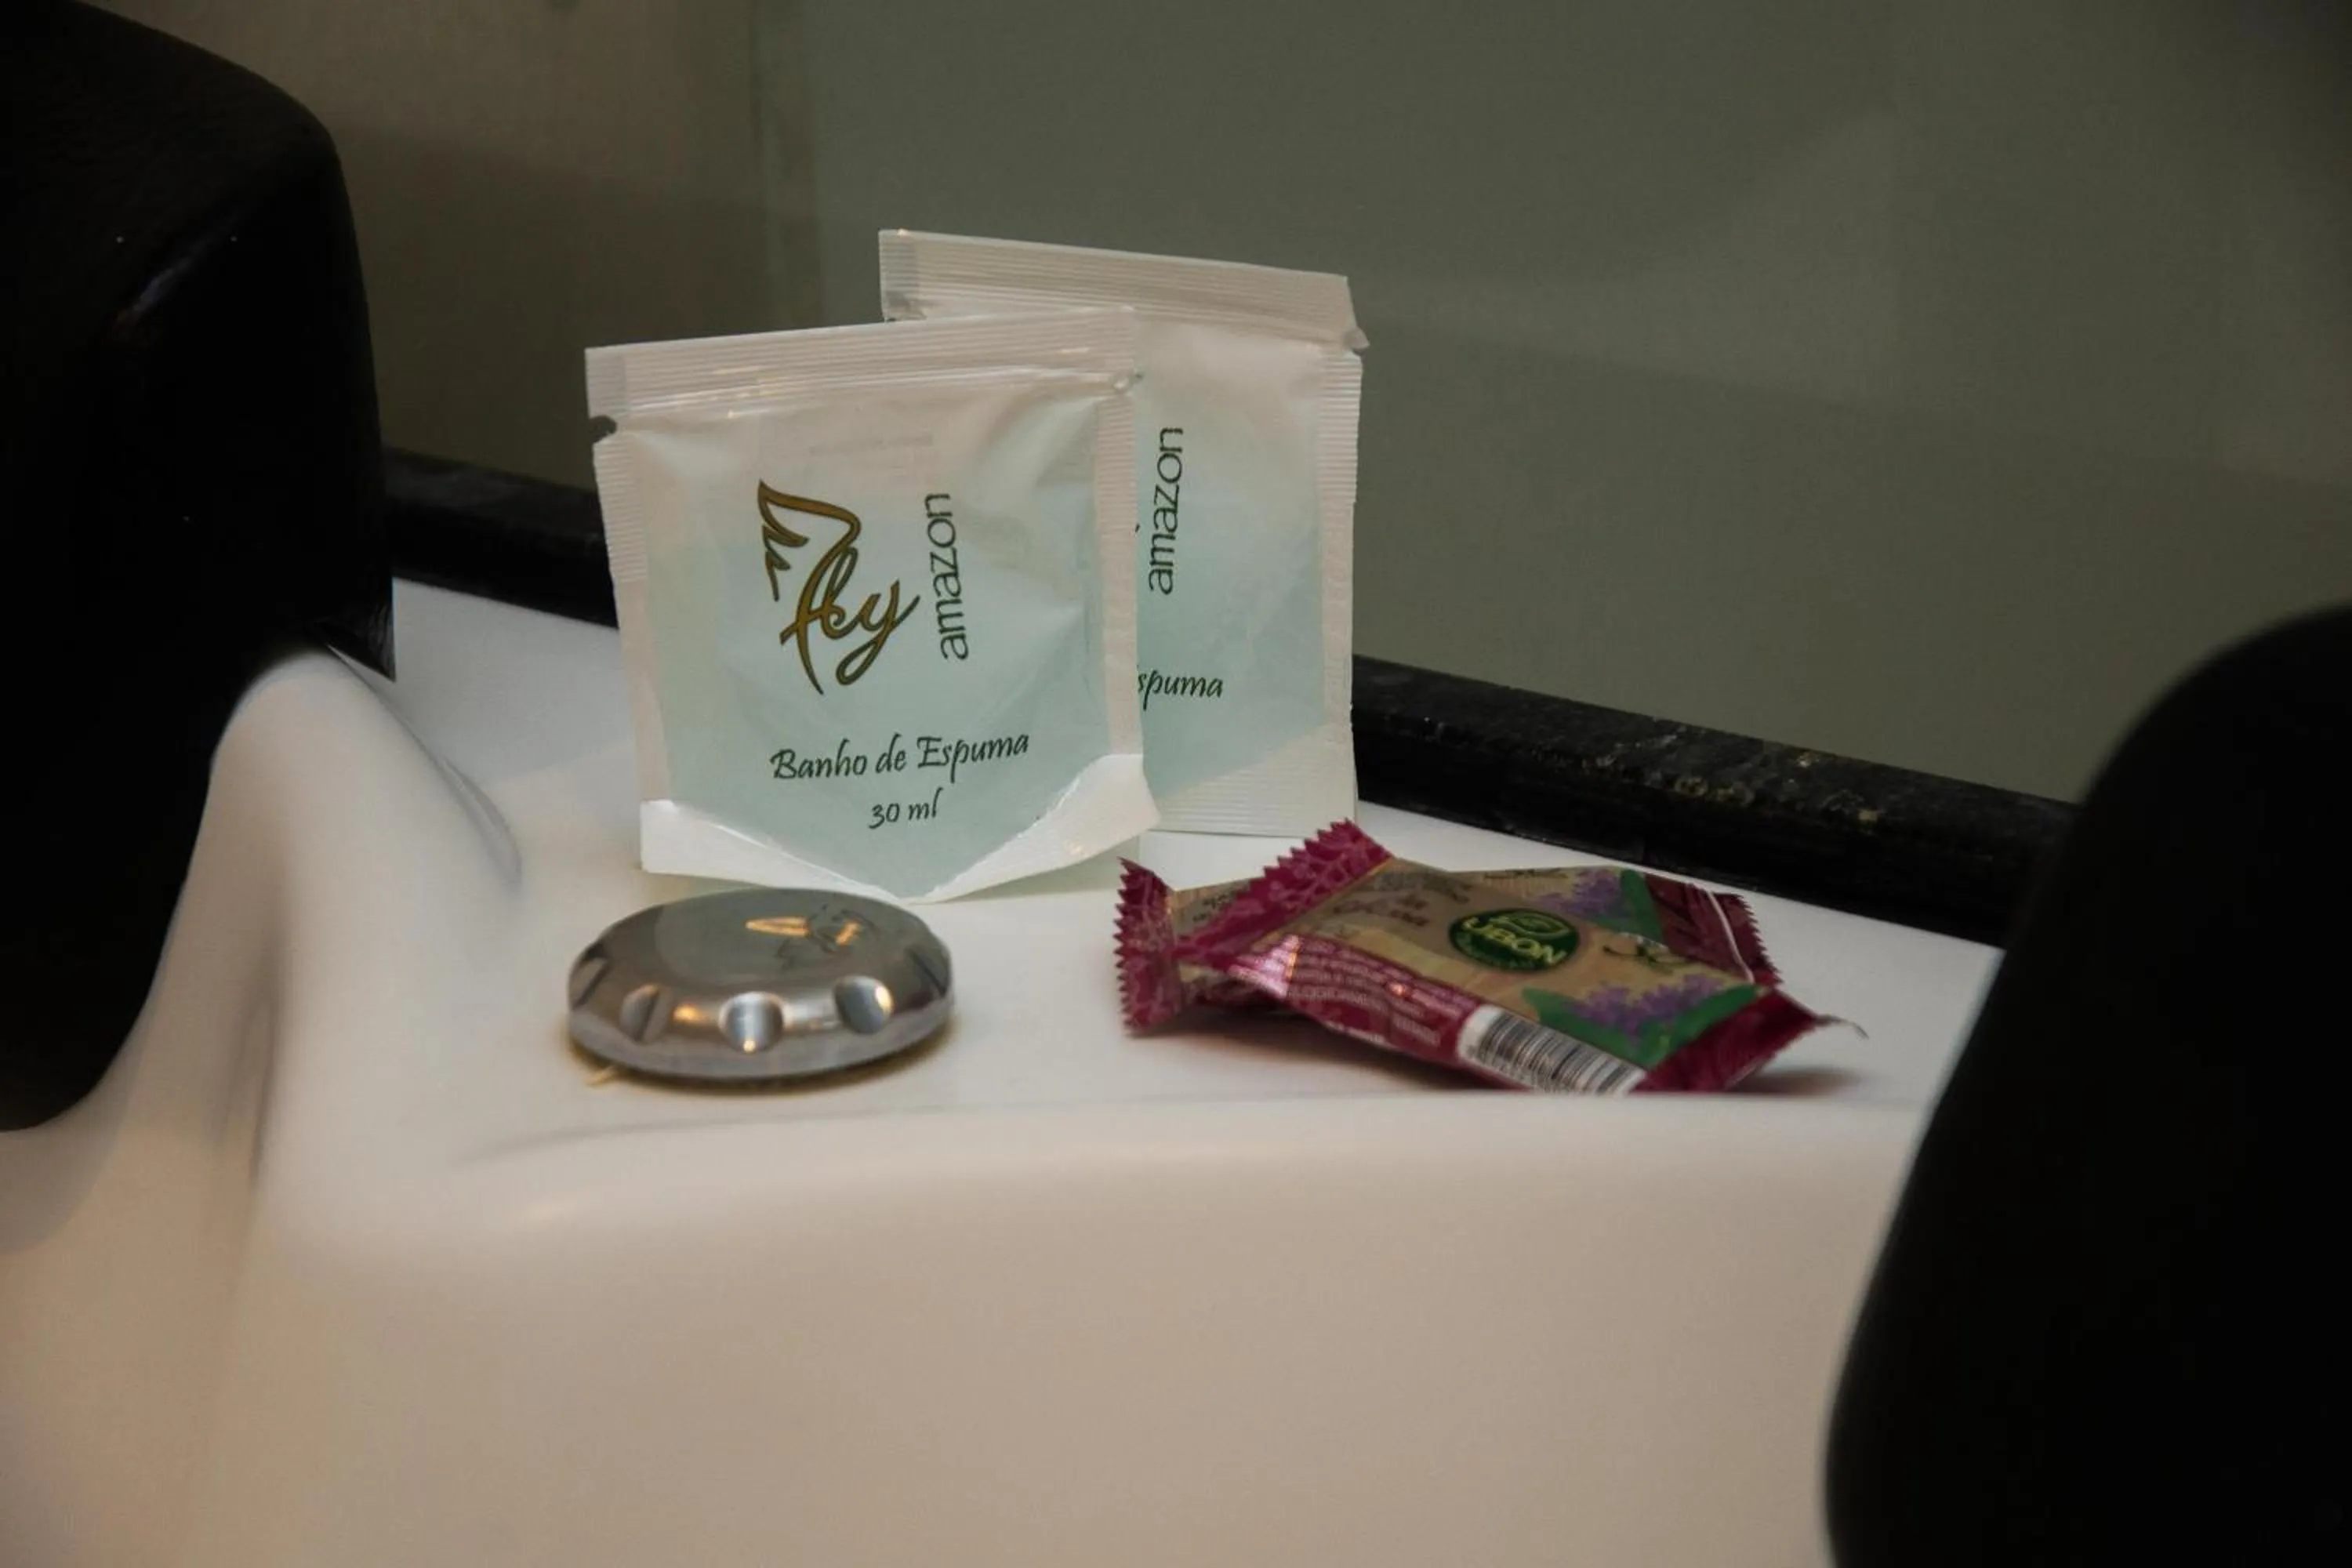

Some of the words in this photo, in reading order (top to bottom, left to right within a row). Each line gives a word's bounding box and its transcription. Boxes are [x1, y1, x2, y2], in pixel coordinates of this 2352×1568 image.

[1149, 427, 1183, 595] amazon
[924, 493, 970, 661] amazon
[1138, 668, 1224, 712] spuma
[769, 737, 867, 780] Banho
[875, 731, 907, 775] de
[916, 734, 1030, 785] Espuma
[868, 802, 901, 830] 30
[907, 786, 945, 821] ml
